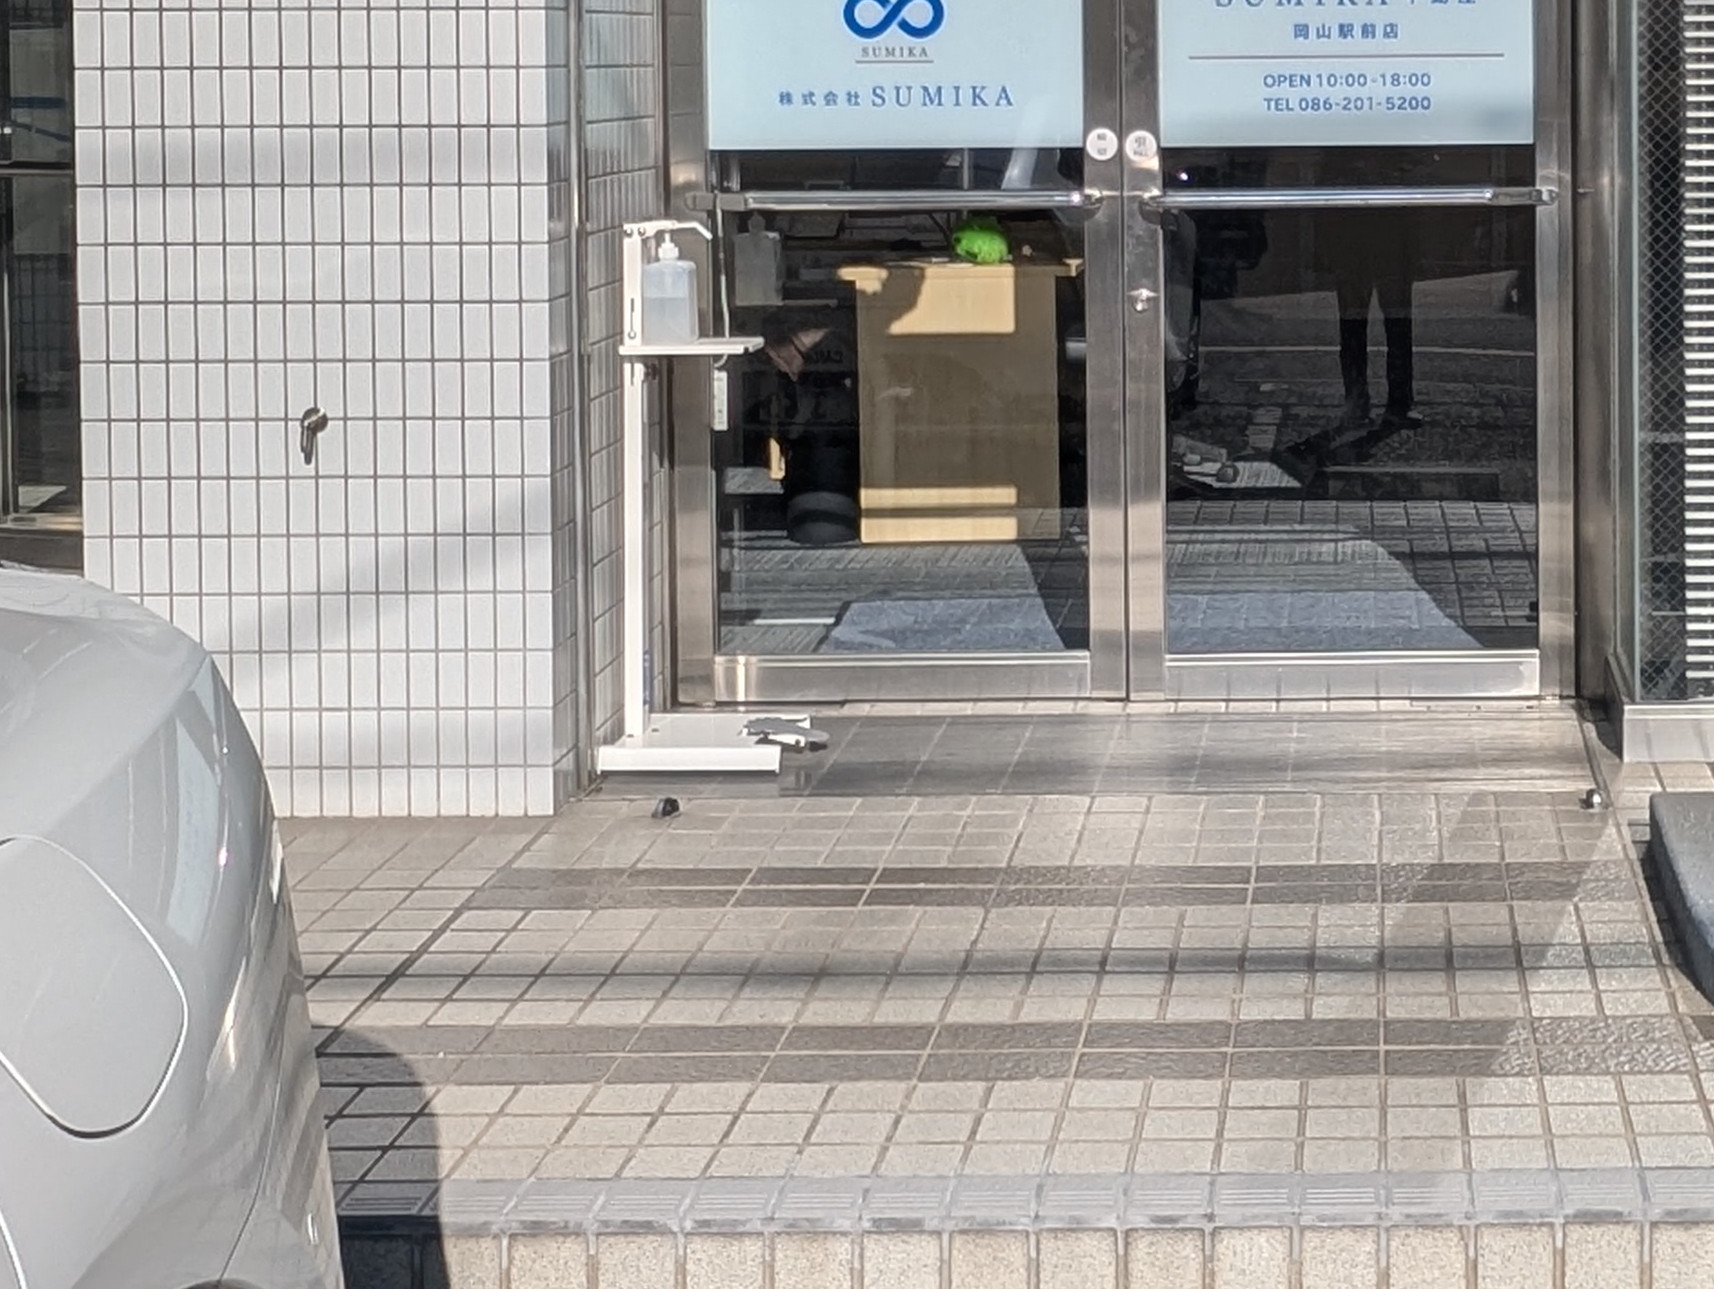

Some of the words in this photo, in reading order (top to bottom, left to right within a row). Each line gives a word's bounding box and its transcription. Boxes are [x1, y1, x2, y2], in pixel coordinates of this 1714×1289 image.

[1293, 22, 1400, 40] 岡山駅前店
[860, 46, 929, 59] SUMIKA
[1262, 73, 1312, 89] OPEN
[1263, 97, 1295, 112] TEL
[1298, 95, 1433, 112] 086-201-5200
